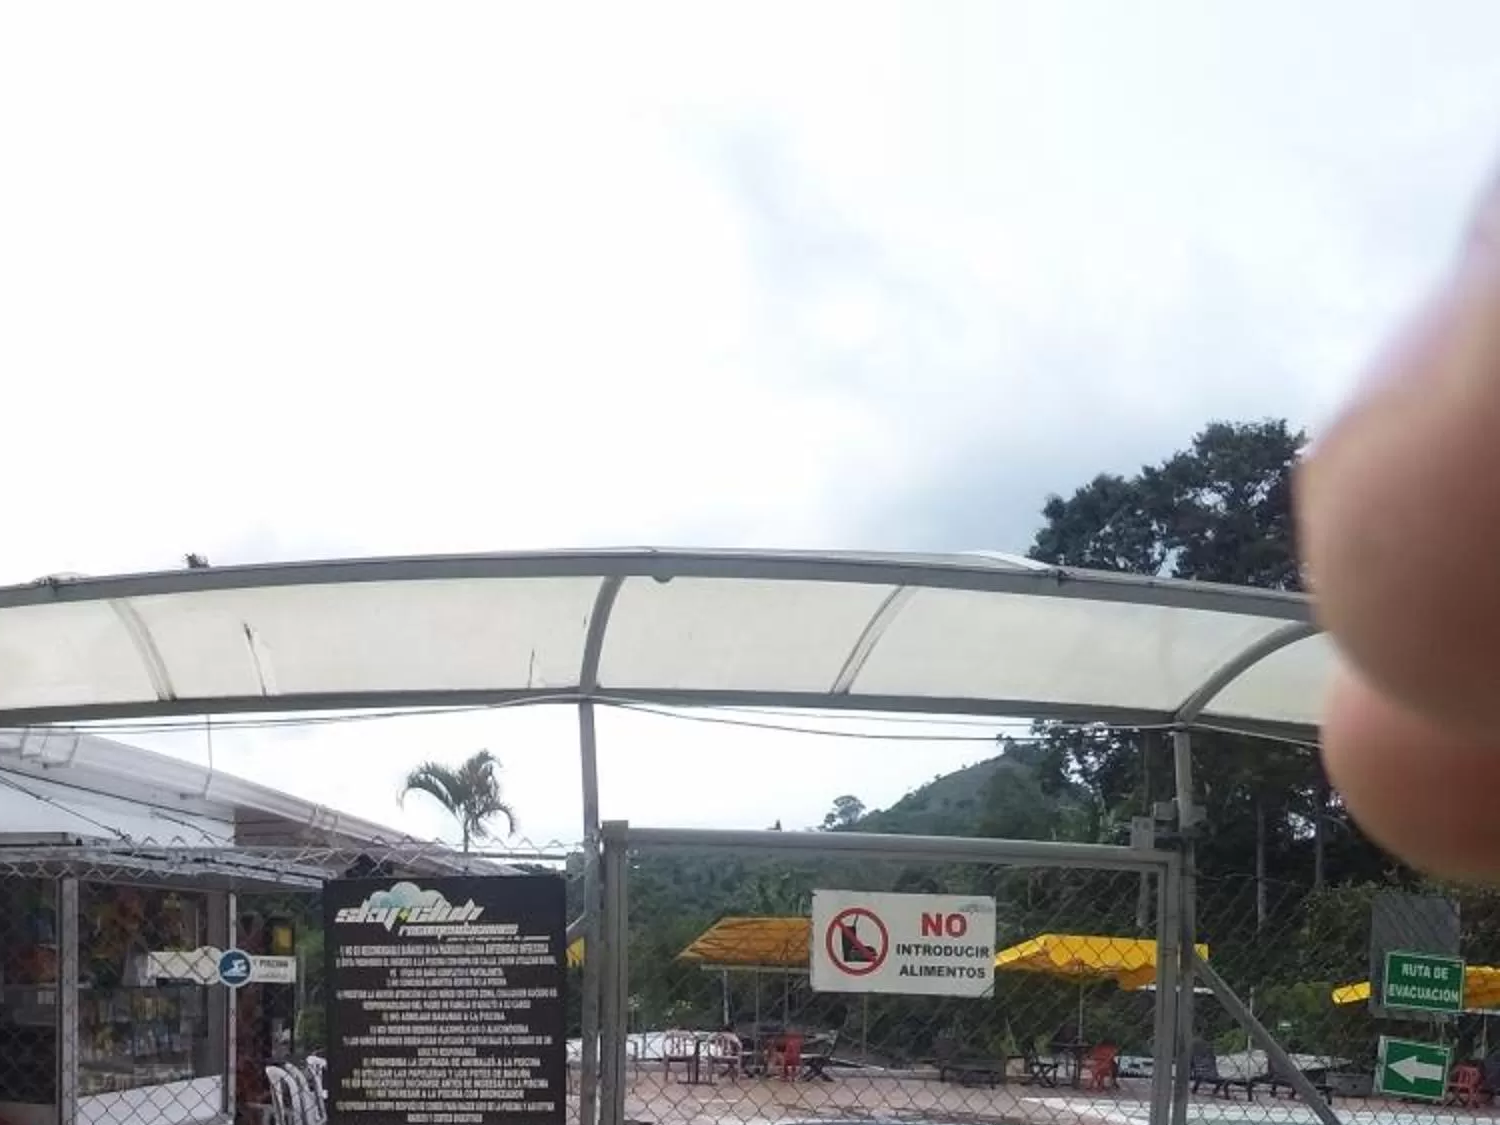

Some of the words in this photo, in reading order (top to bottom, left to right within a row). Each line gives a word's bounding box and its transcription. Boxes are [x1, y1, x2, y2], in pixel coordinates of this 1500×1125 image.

[921, 912, 967, 938] NO
[896, 943, 990, 959] INTRODUCIR
[899, 965, 986, 979] ALIMENTOS
[1401, 963, 1431, 979] RUTA
[1433, 966, 1449, 980] DE
